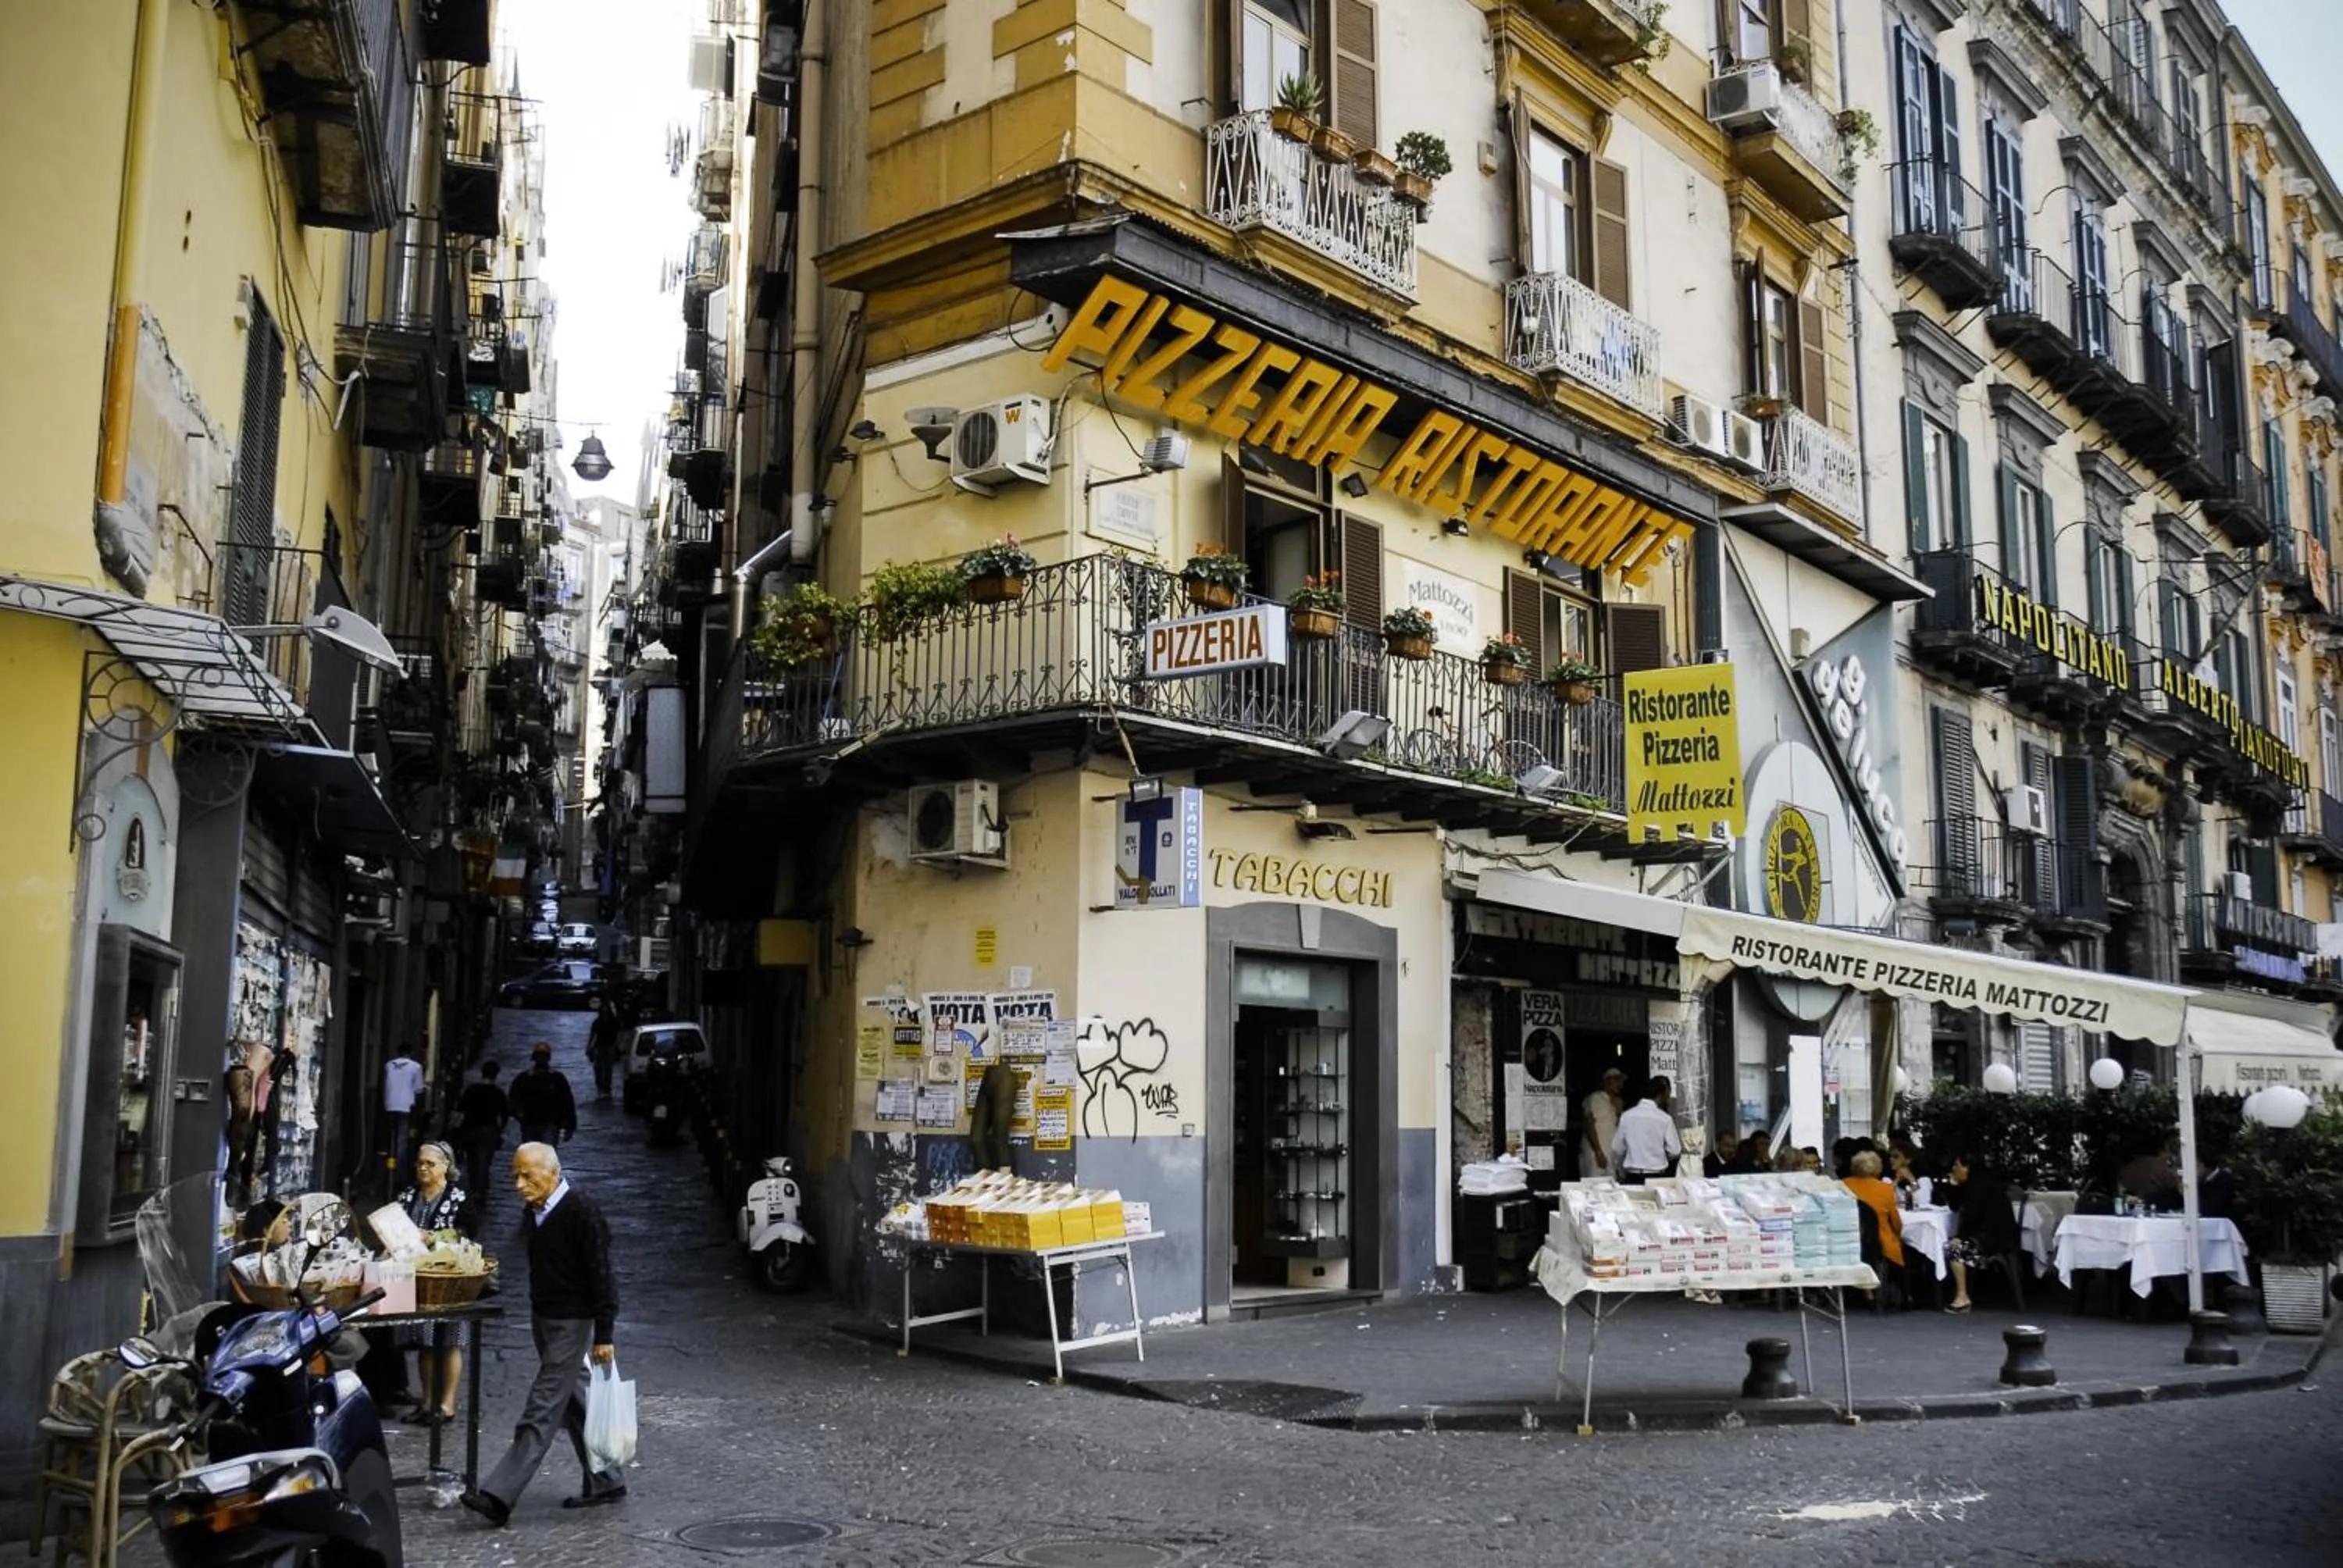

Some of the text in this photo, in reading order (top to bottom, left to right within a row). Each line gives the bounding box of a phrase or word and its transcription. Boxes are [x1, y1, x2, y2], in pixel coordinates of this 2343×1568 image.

[1042, 273, 1695, 586] PIZZERIA RISTORANTE
[1408, 580, 1474, 624] Mattozzi
[1152, 615, 1263, 672] PIZZERIA
[1982, 574, 2129, 690] NAPOLITANO
[2164, 657, 2239, 733] ALBERTO
[1628, 682, 1730, 723] Ristorante
[1642, 727, 1721, 767] Pizzeria
[1632, 777, 1735, 814] Mattozzi
[1186, 801, 1199, 893] TABACCHI
[1147, 885, 1175, 898] OLLATI
[1209, 848, 1394, 908] TABACCHI
[1578, 952, 1679, 989] MATTOZZ
[1731, 935, 2110, 1024] RISTORANTE PIZZERIA MATTOZZI
[930, 1003, 986, 1025] VOTA
[993, 1002, 1054, 1025] VOTA
[1524, 992, 1561, 1010] VERA
[1524, 1010, 1563, 1027] PIZZA
[1649, 1021, 1681, 1035] RISTOR
